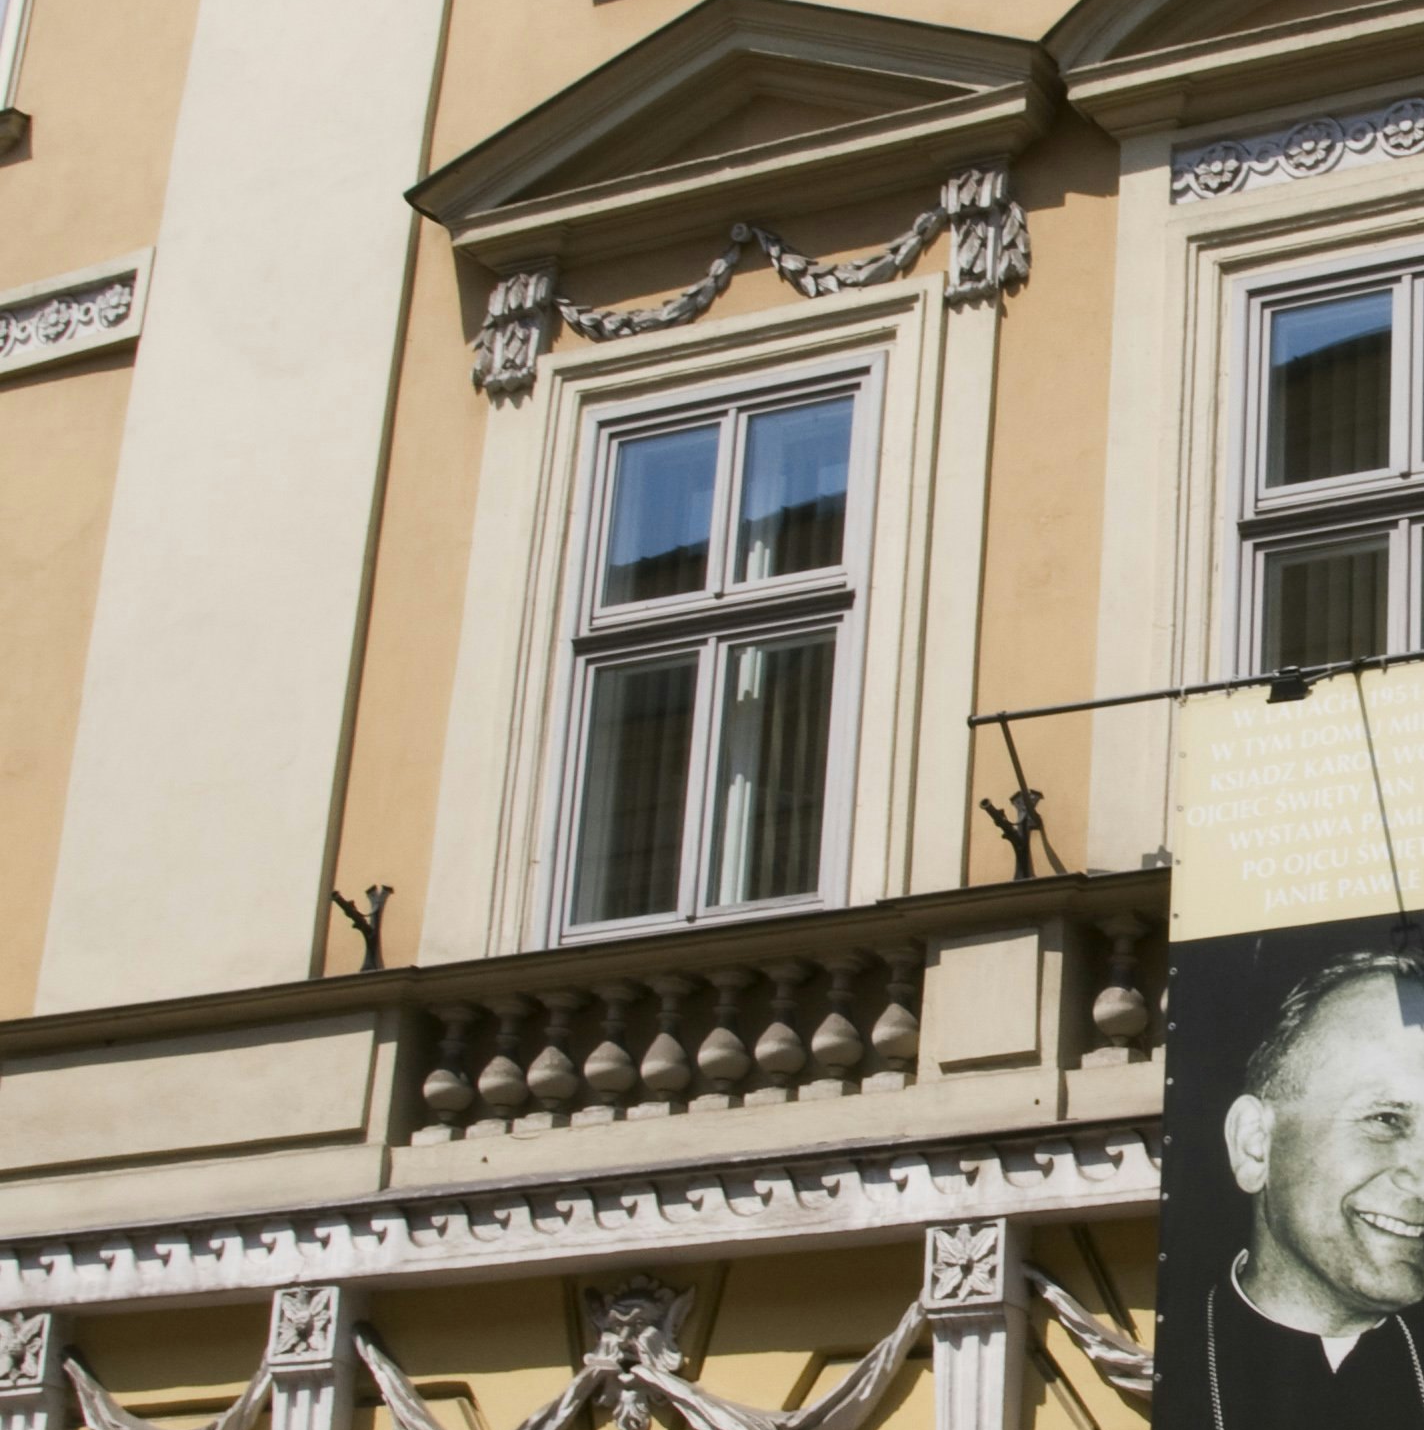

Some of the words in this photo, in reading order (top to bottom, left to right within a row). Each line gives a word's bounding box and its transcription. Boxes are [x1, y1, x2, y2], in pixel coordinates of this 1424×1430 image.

[1231, 708, 1257, 729] W
[1263, 691, 1360, 725] LATACH
[1210, 741, 1236, 763] W
[1244, 733, 1293, 758] TYM
[1186, 795, 1270, 829] OJCIEC
[1229, 815, 1354, 852] WYSTAWA
[1241, 856, 1277, 882] PO
[1281, 847, 1351, 877] OJCU
[1263, 880, 1331, 915] JANIE
